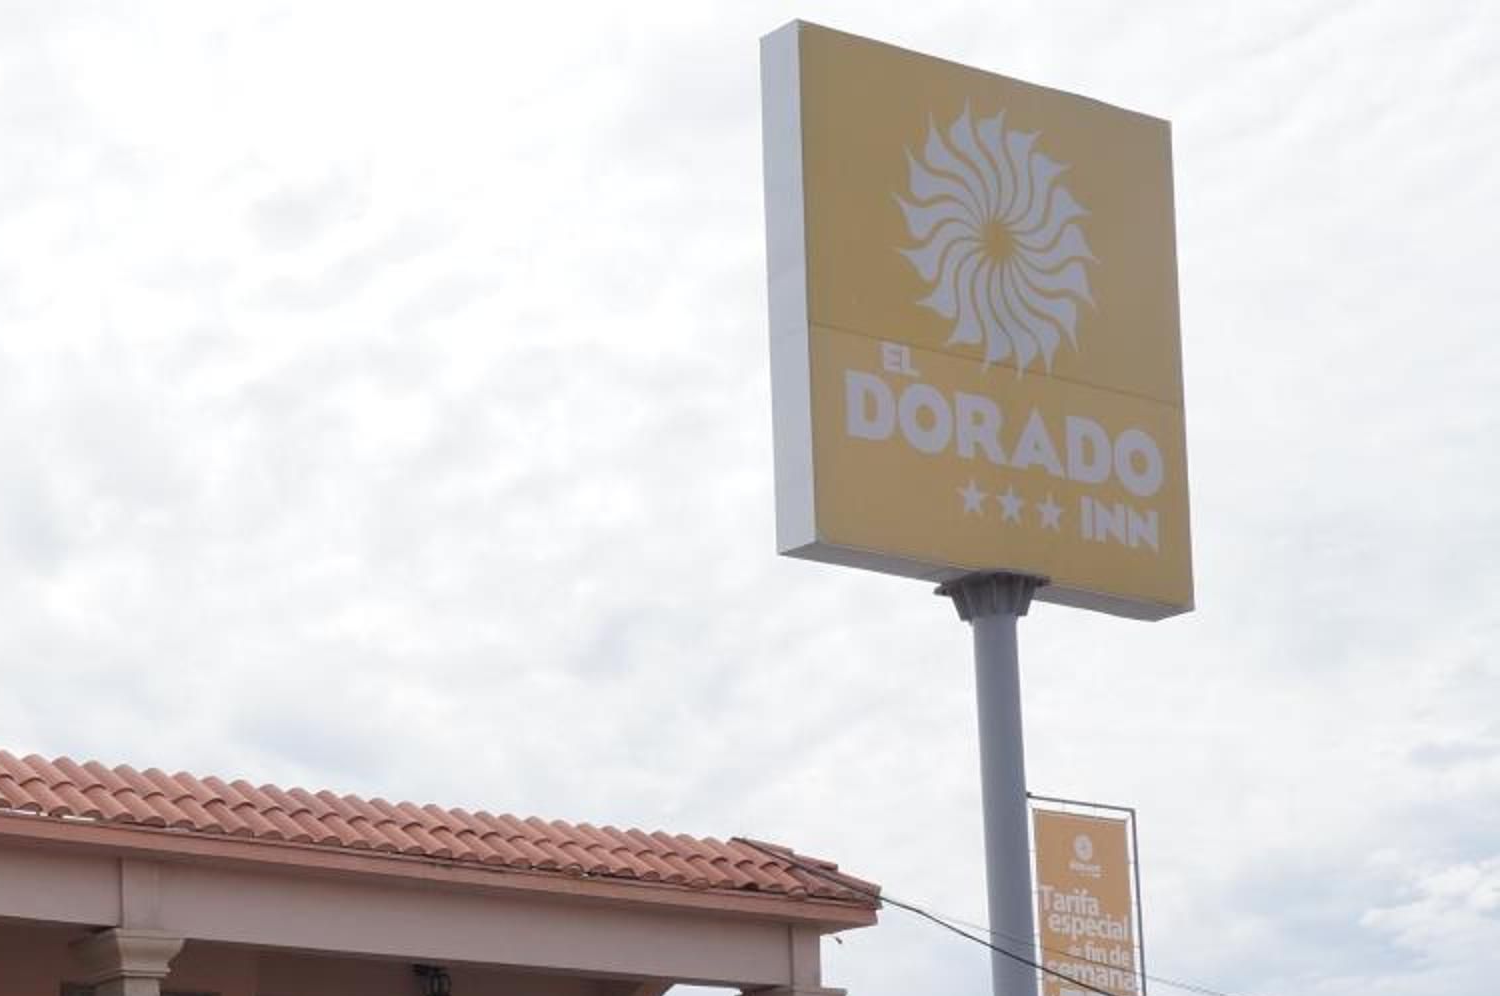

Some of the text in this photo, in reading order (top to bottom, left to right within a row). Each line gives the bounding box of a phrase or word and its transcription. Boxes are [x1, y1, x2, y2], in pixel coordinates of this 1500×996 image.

[879, 341, 920, 377] EL
[844, 368, 1164, 496] DORADO
[1080, 495, 1160, 551] INN
[1040, 886, 1100, 915] Tarifa
[1048, 913, 1130, 941] especial
[1085, 941, 1108, 965] fin
[1109, 944, 1132, 968] de
[1045, 959, 1137, 992] semana
